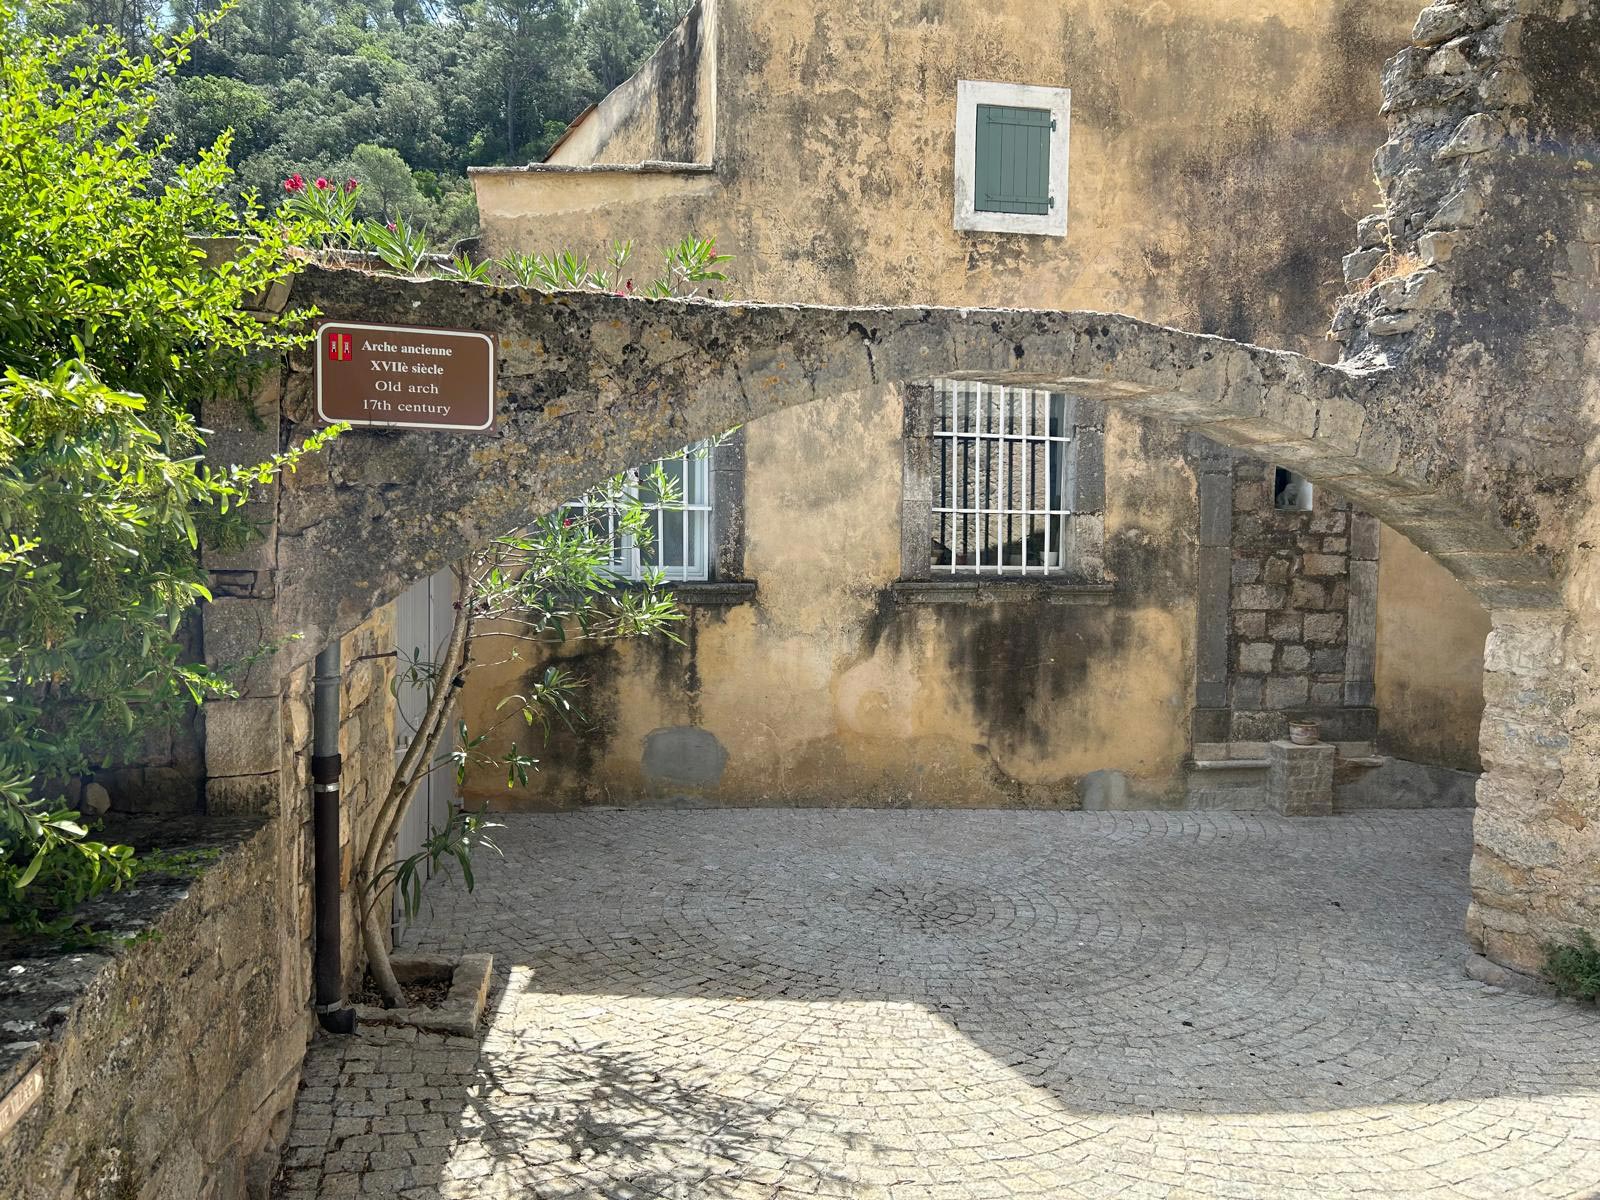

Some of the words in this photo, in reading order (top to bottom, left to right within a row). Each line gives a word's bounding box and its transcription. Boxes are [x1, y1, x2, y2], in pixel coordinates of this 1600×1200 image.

[361, 340, 398, 353] Arche
[401, 344, 453, 357] ancienne
[370, 360, 409, 373] XVIIè
[411, 363, 444, 375] siècle
[375, 380, 402, 392] Old
[408, 383, 439, 394] arch
[363, 399, 391, 411] 17th
[397, 403, 451, 416] century
